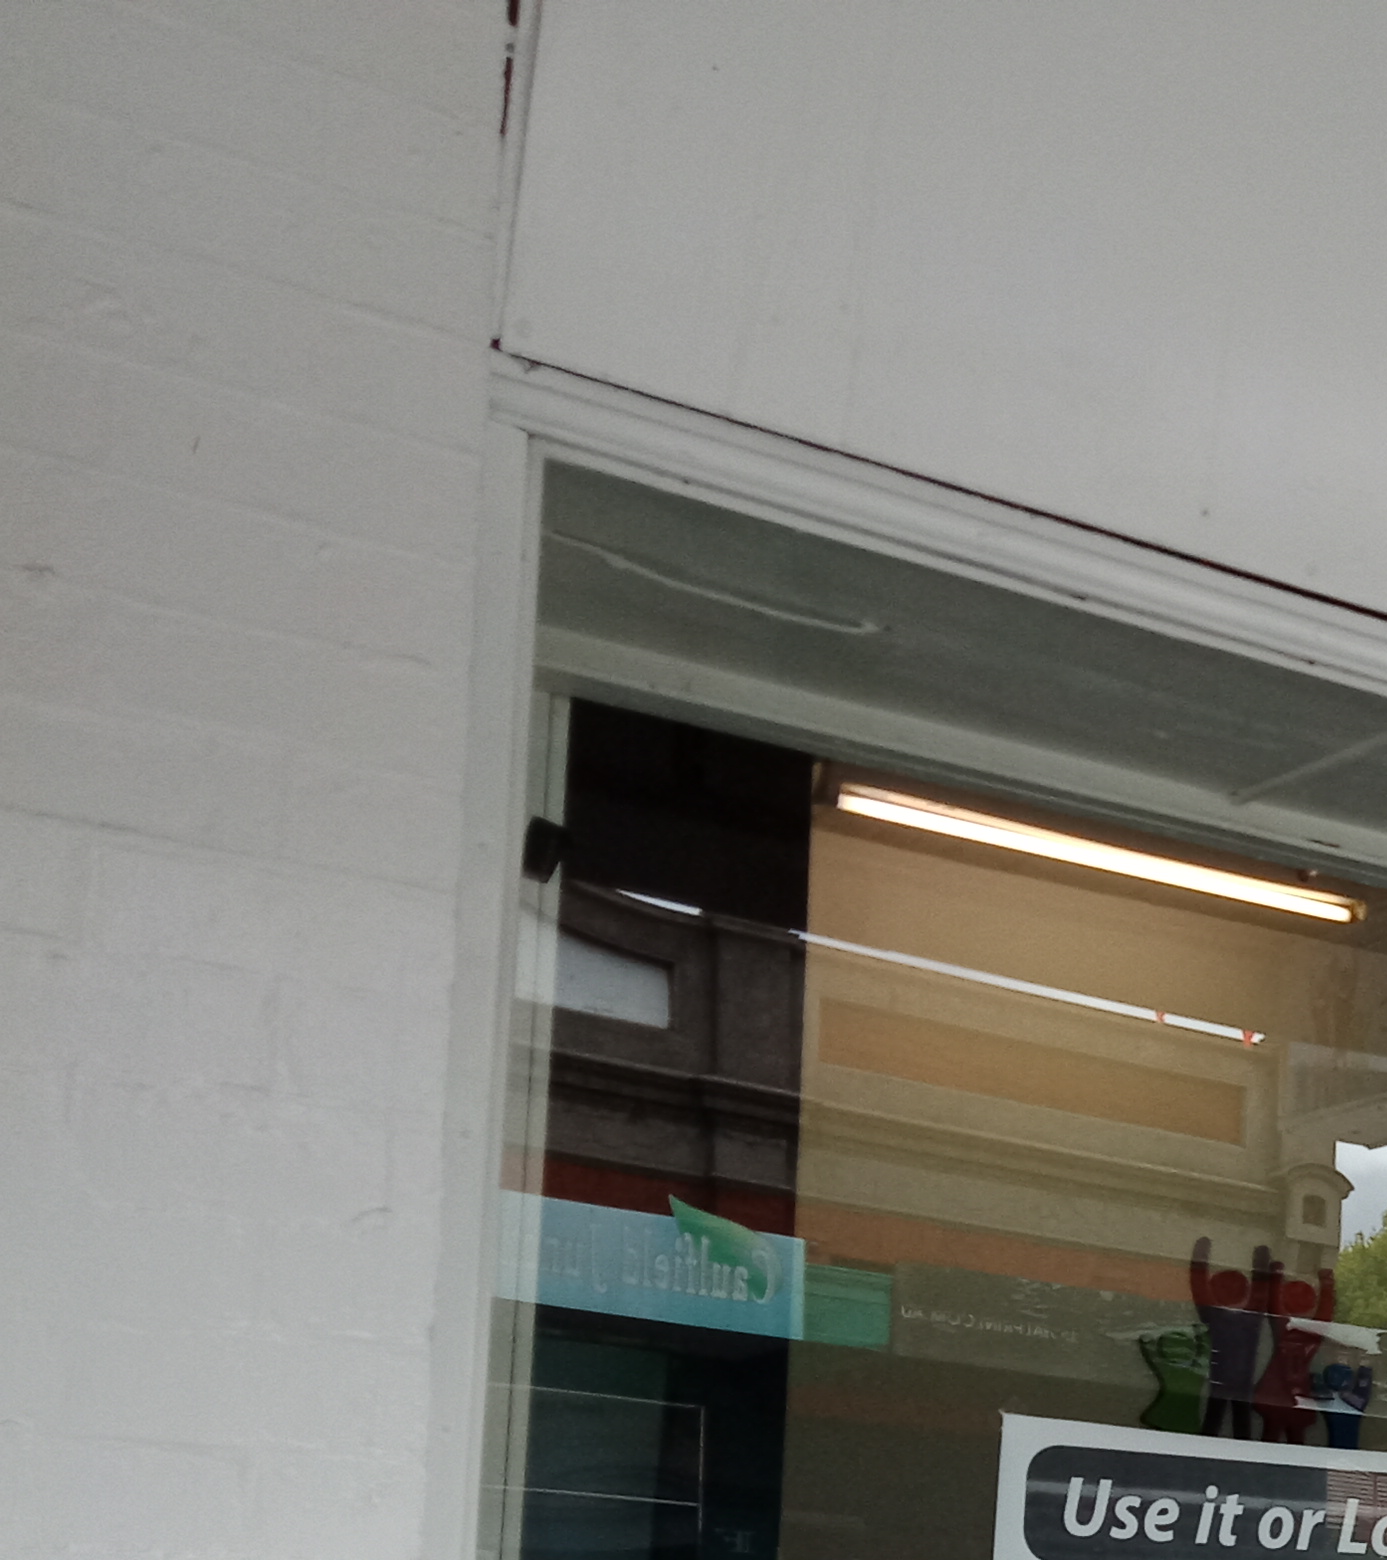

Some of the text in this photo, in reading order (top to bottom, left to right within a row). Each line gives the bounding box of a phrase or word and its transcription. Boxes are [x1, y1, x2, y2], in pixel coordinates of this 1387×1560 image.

[1061, 1476, 1180, 1544] Use
[1194, 1485, 1242, 1548] it
[1257, 1506, 1326, 1551] or
